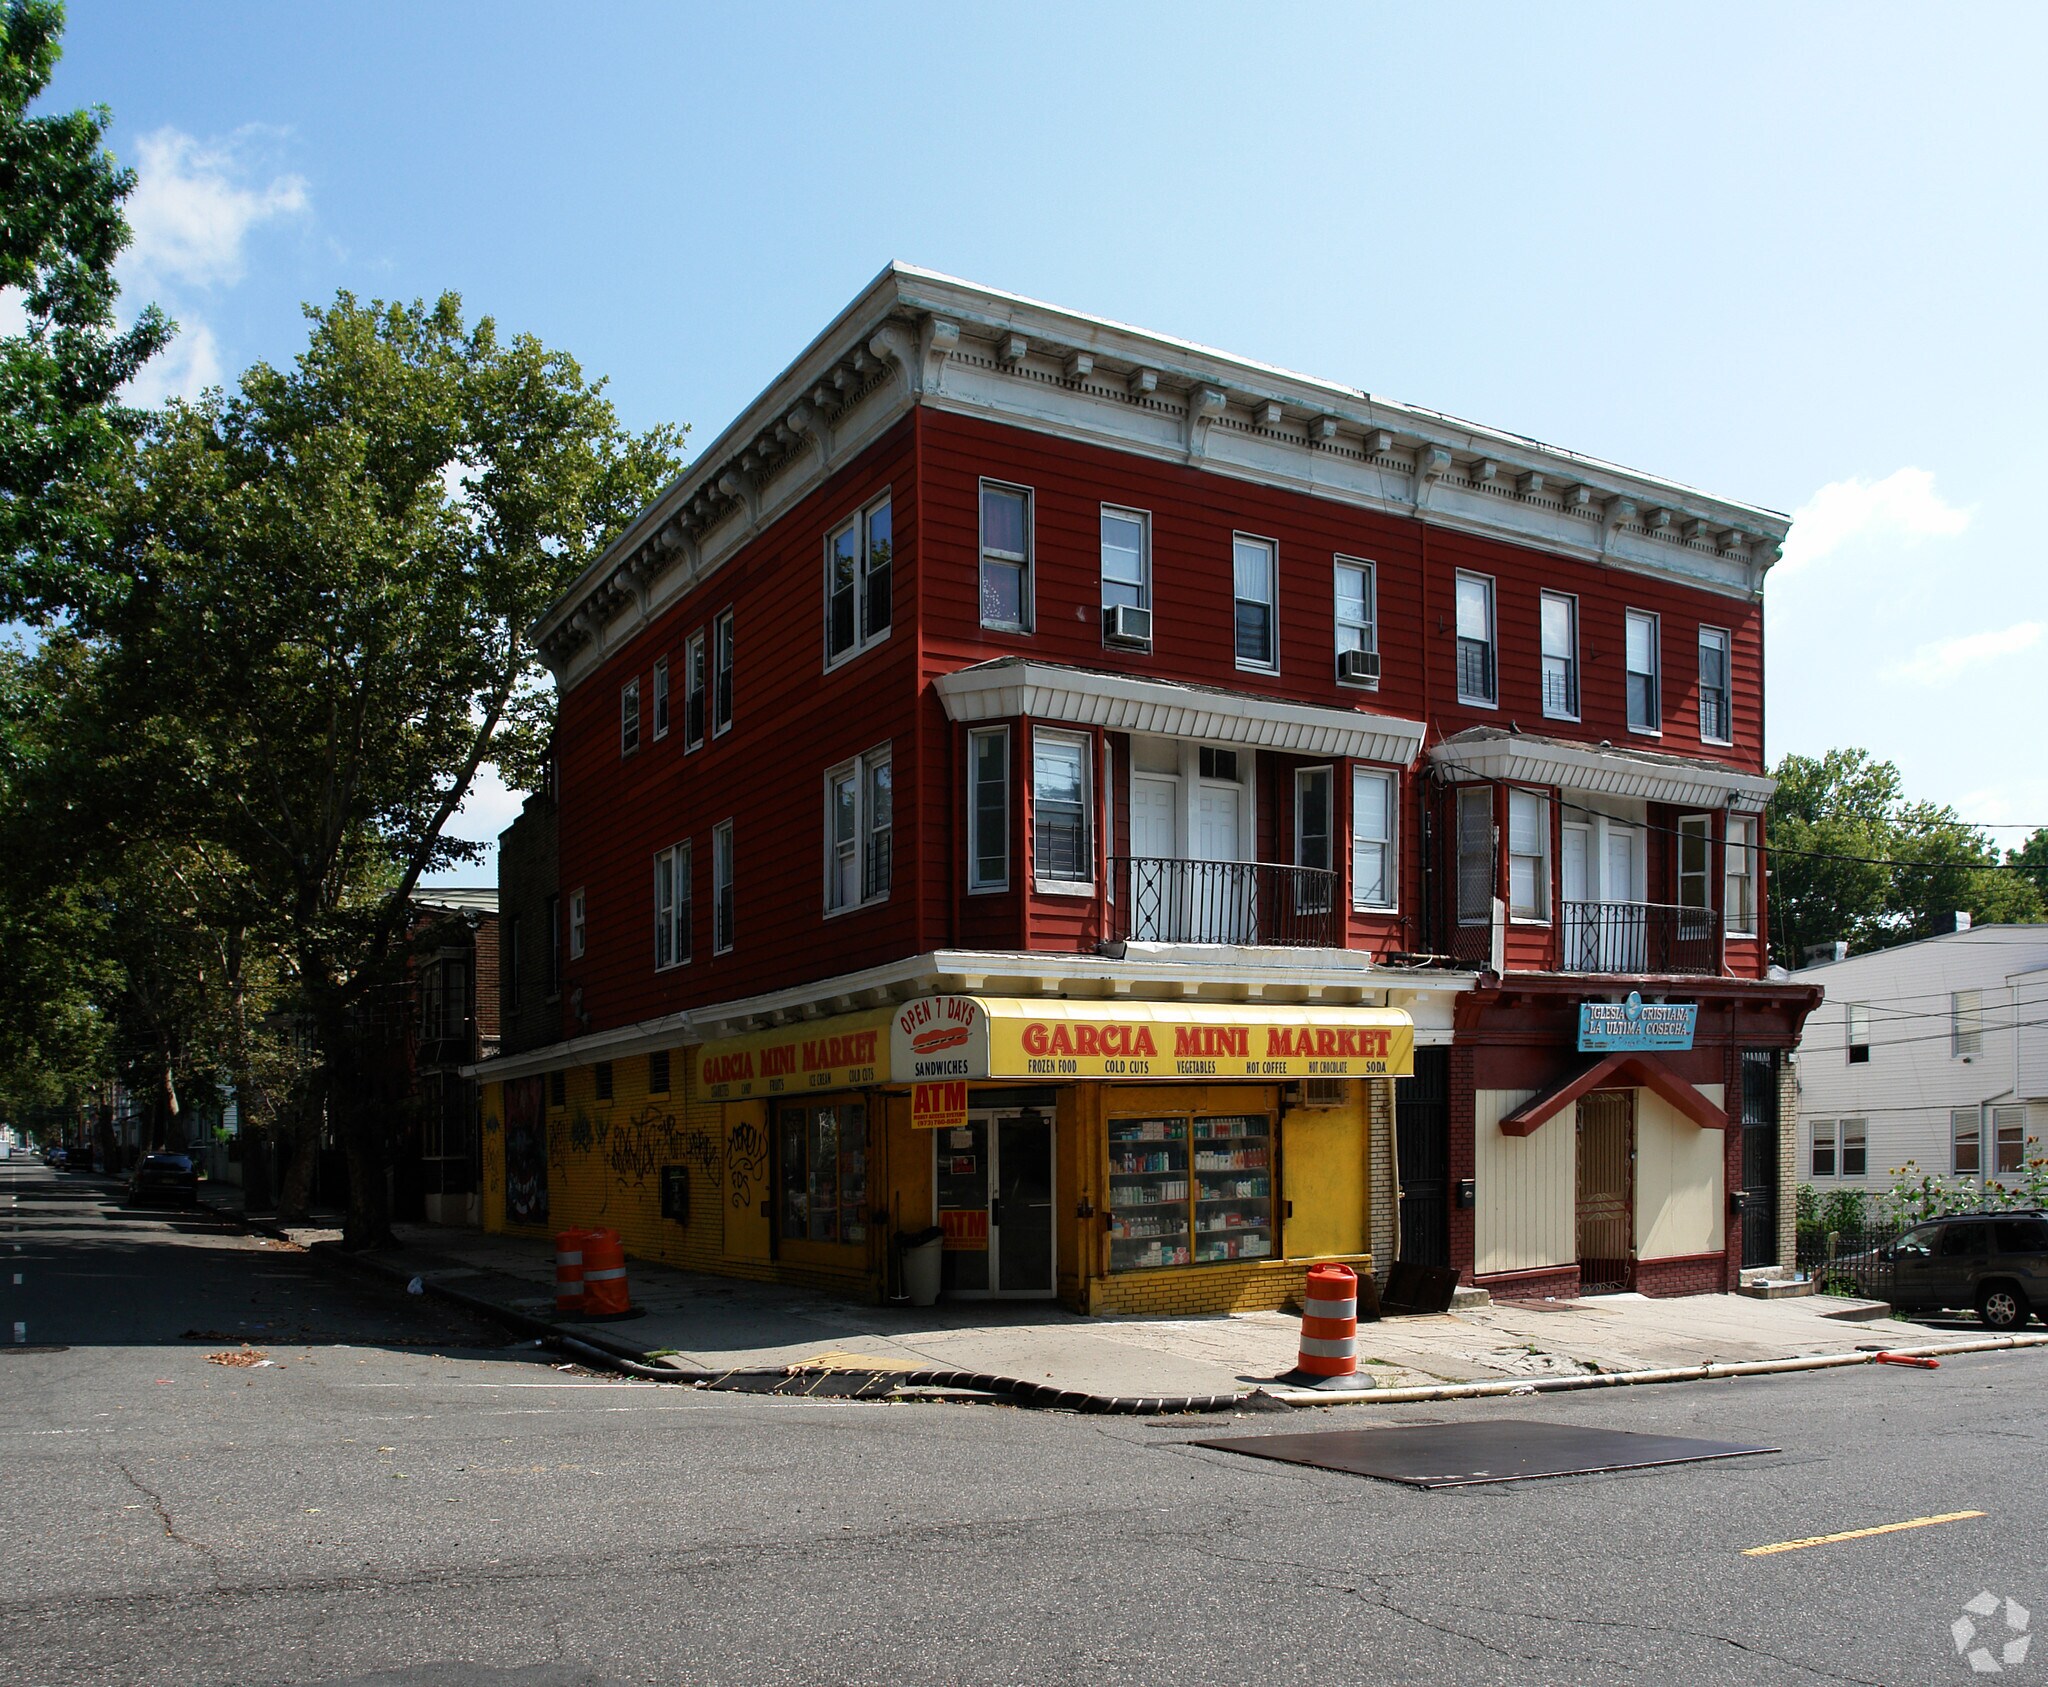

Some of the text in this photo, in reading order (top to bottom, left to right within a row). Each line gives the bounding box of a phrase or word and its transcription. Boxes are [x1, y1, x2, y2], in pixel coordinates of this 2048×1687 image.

[900, 997, 975, 1035] OPEN 7 DAYS
[1591, 1006, 1689, 1021] IGLESIA CRISTIANA
[1022, 1023, 1392, 1058] GARCIA MINI MARKET
[1589, 1020, 1687, 1036] LA ULTIMA COSECHA
[703, 1030, 878, 1085] GARCIA MINI MARKET
[915, 1059, 968, 1077] SANDWICHES
[1028, 1059, 1387, 1074] FROZEN FOOD COLD CUTS VEGETABLES HOT COFFEE HOT CHOCOLATE SODA
[769, 1078, 784, 1092] FRUITS
[809, 1074, 817, 1087] ICE
[817, 1072, 831, 1086] CREAM
[849, 1068, 860, 1083] COLD
[862, 1067, 874, 1081] CUTS
[914, 1082, 965, 1113] ATM
[942, 1212, 986, 1237] ATM
